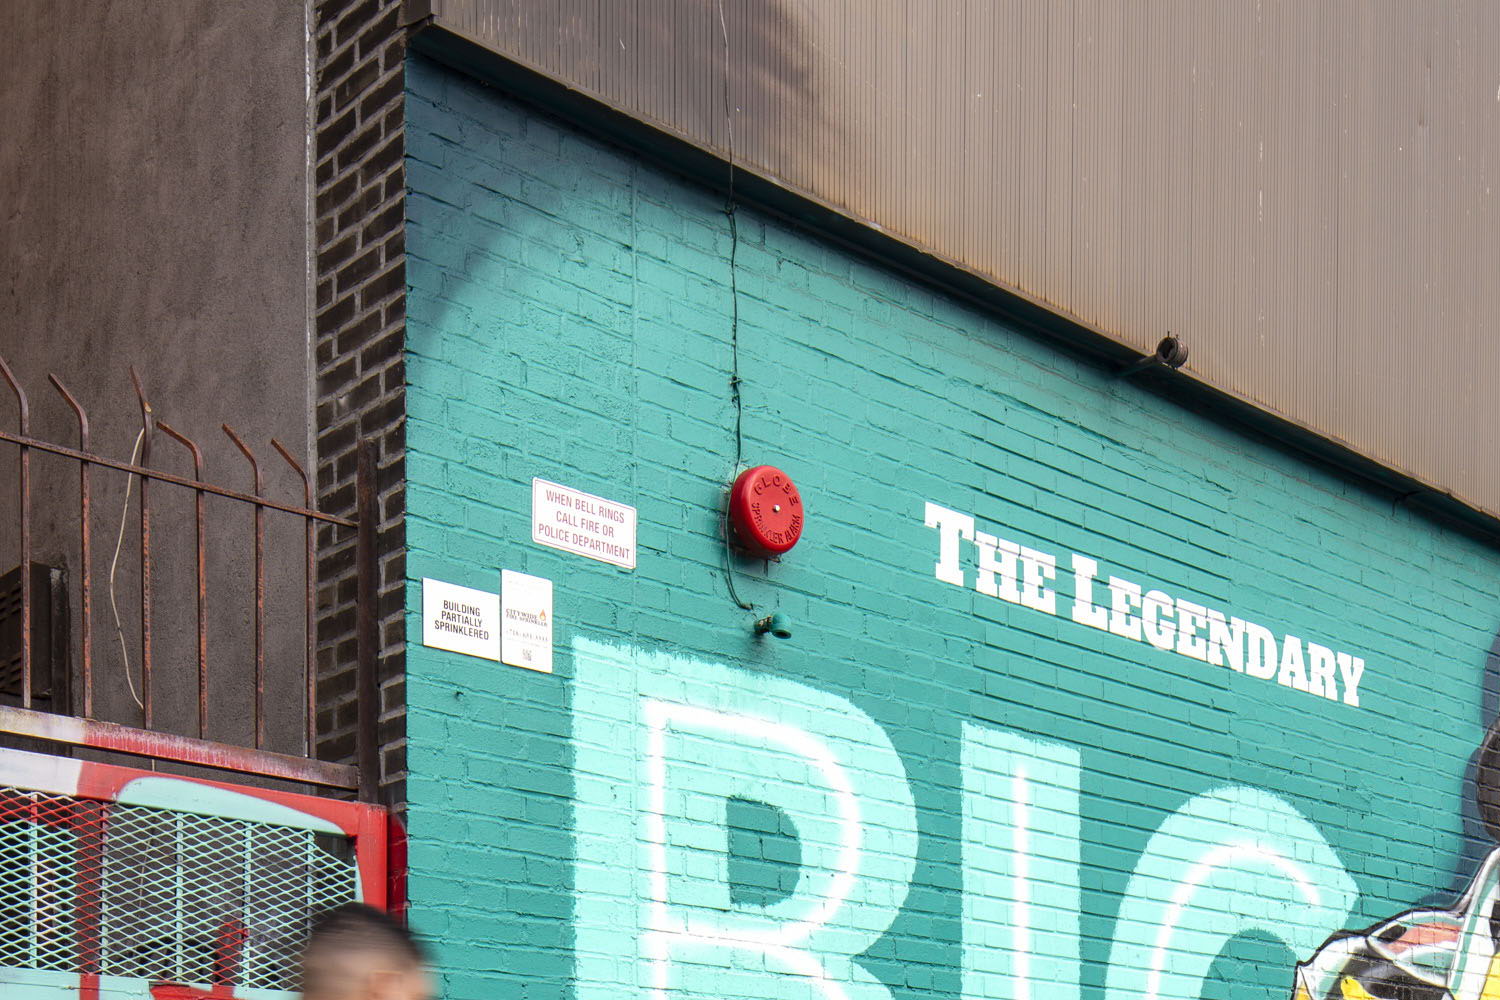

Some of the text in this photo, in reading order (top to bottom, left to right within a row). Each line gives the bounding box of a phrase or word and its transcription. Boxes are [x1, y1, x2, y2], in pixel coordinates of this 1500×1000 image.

[546, 489, 624, 524] WHEN BELL RINGS
[556, 510, 614, 538] CALL FIRE OR
[538, 523, 630, 560] POLICE DEPARTMENT
[443, 599, 481, 617] BUILDING
[505, 608, 538, 621] CITYWIDE
[924, 502, 1366, 708] THE LEGENDARY
[434, 619, 489, 641] SPRINKLERED
[441, 610, 483, 628] PARTIALLY
